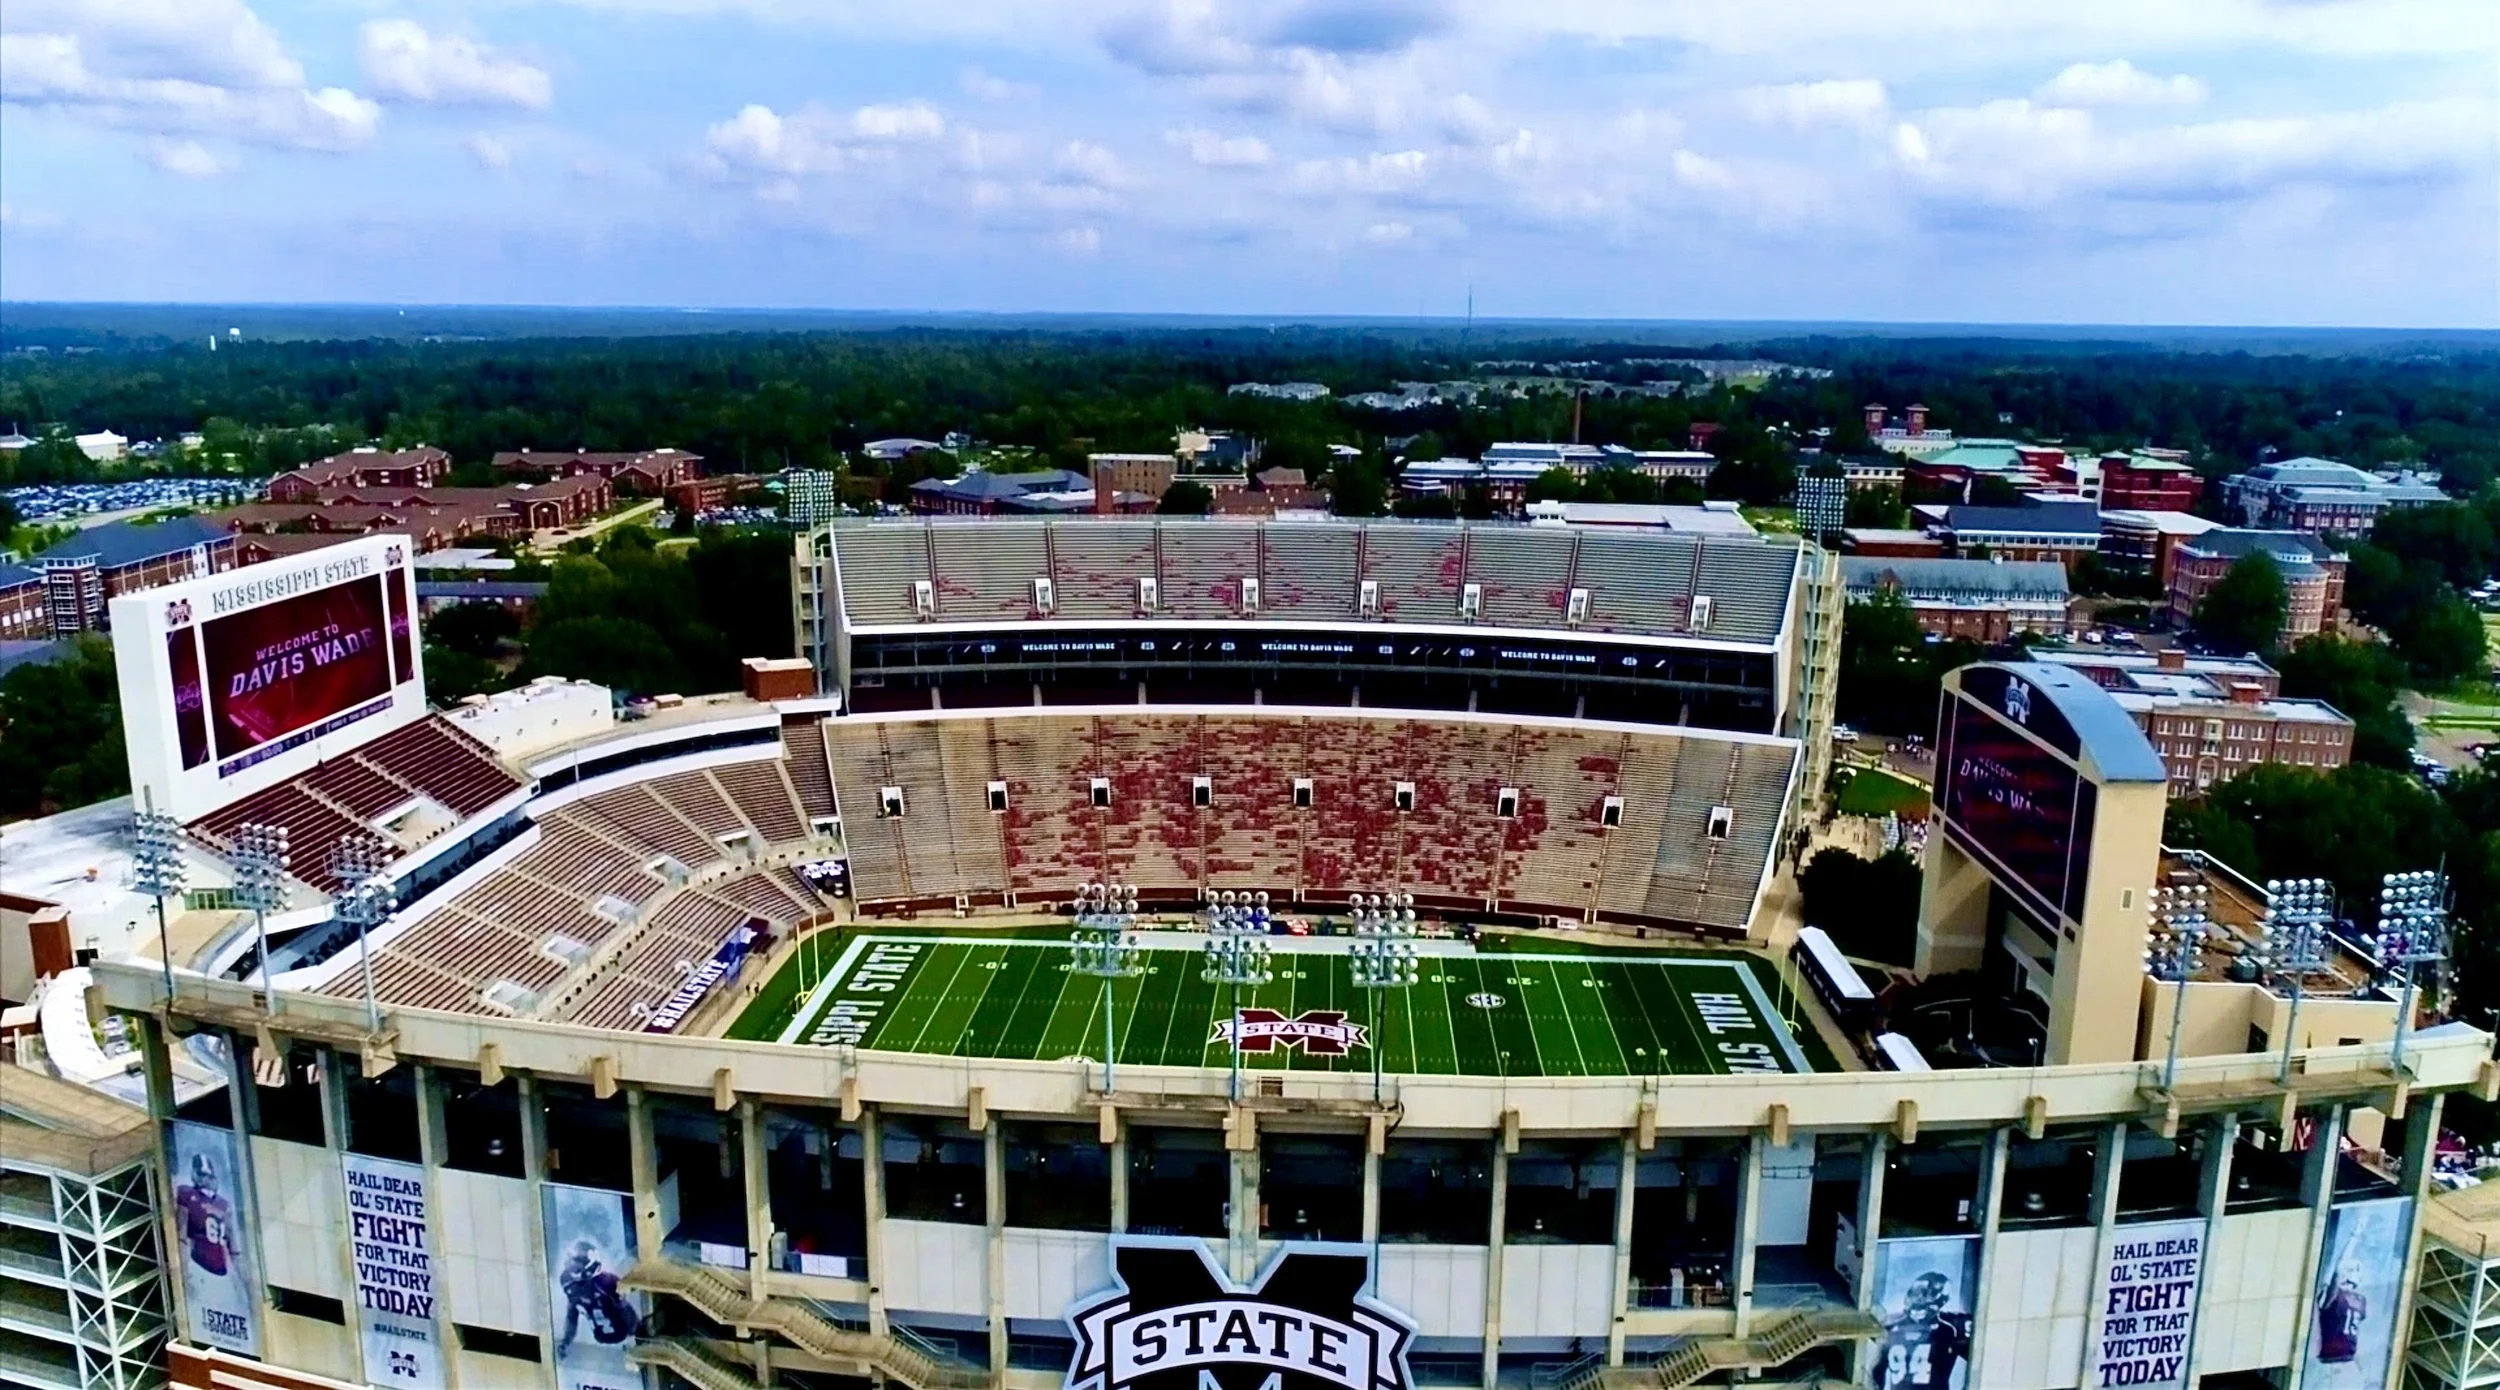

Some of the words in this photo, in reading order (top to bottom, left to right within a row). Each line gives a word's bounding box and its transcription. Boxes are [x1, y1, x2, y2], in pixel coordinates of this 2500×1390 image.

[212, 567, 319, 613] MISSISSIPPI
[324, 555, 370, 583] STATE
[256, 630, 320, 661] WELCOME
[323, 623, 340, 637] TO
[1095, 642, 1115, 650] WADE
[1261, 643, 1297, 651] WELCOME
[230, 652, 304, 698] DAVIS
[310, 628, 376, 666] WADE
[1501, 651, 1538, 659] WELCOME
[1540, 652, 1550, 660] TO
[1551, 653, 1573, 661] DAVIS
[1575, 655, 1596, 663] WADE
[847, 944, 922, 992] STATE
[1469, 993, 1501, 1008] SEC
[1691, 992, 1756, 1034] HAIL
[1245, 1022, 1336, 1038] STATE
[348, 1170, 381, 1190] HAIL
[383, 1176, 422, 1197] DEAR
[350, 1190, 371, 1209] OL'
[374, 1194, 424, 1219] STATE
[352, 1211, 426, 1249] FIGHT
[355, 1241, 385, 1262] FOR
[388, 1248, 429, 1270] THAT
[2114, 1243, 2152, 1260] HAIL
[2155, 1238, 2198, 1257] DEAR
[357, 1262, 431, 1292] VICTORY
[2110, 1264, 2137, 1282] OL'
[2140, 1259, 2196, 1280] STATE
[360, 1284, 433, 1320] TODAY
[2106, 1280, 2193, 1314] FIGHT
[207, 1309, 247, 1331] STATE
[2104, 1317, 2137, 1336] FOR
[2143, 1312, 2189, 1332] THAT
[1132, 1309, 1348, 1377] STATE
[2103, 1334, 2186, 1359] VICTORY
[1888, 1343, 1932, 1385] 94
[2099, 1356, 2183, 1387] TODAY
